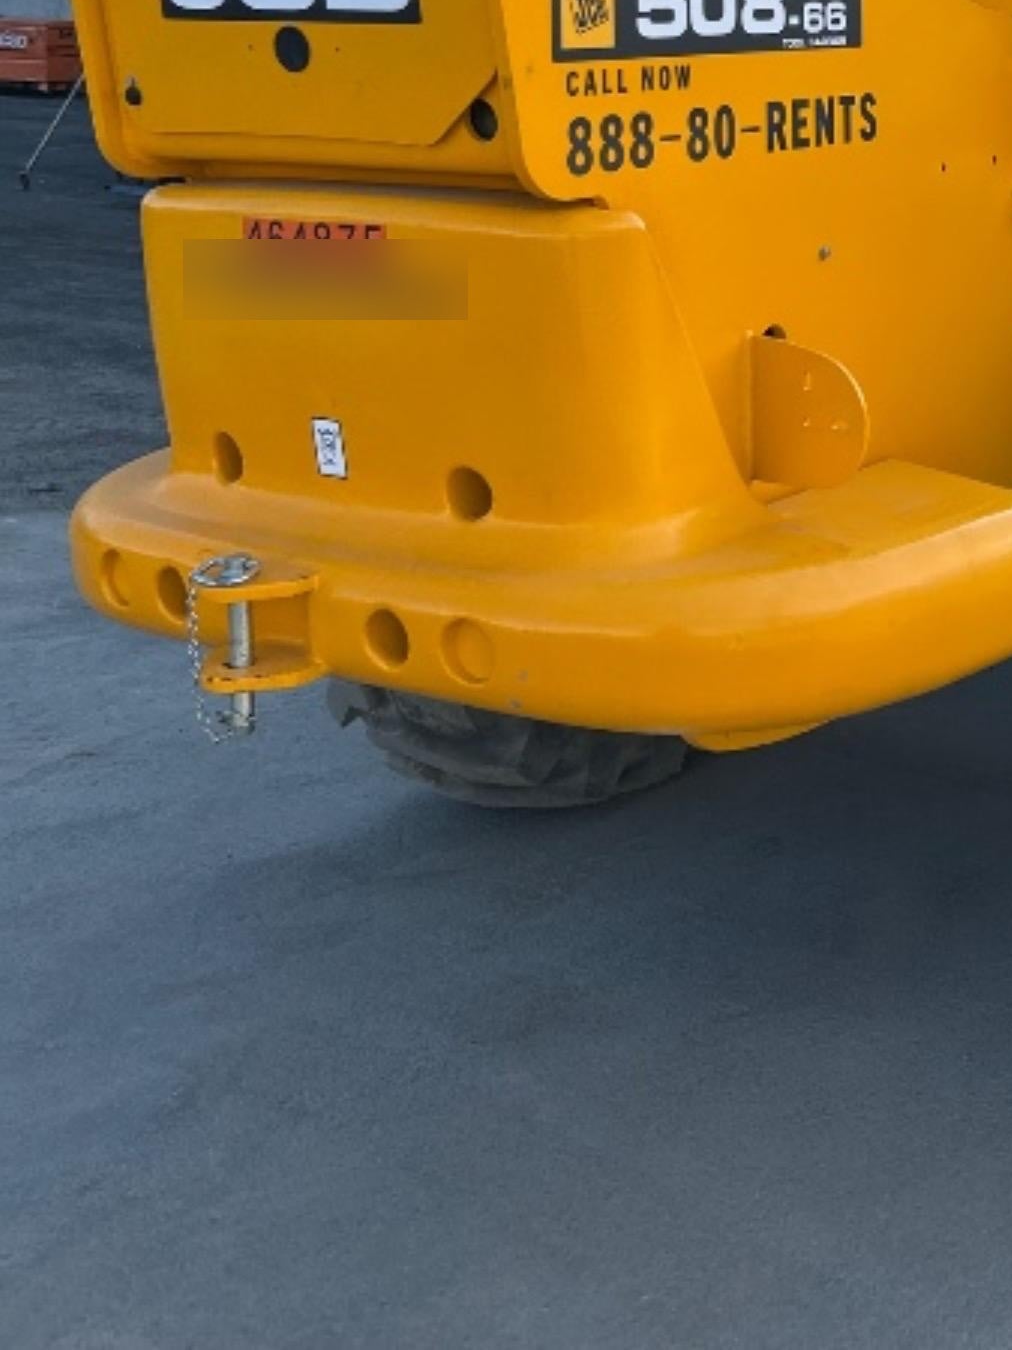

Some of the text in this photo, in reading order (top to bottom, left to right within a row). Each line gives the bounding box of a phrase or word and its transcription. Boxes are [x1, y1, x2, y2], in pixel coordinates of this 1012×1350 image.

[565, 63, 692, 97] CALL NOW
[565, 91, 878, 177] 888-80-RENTS
